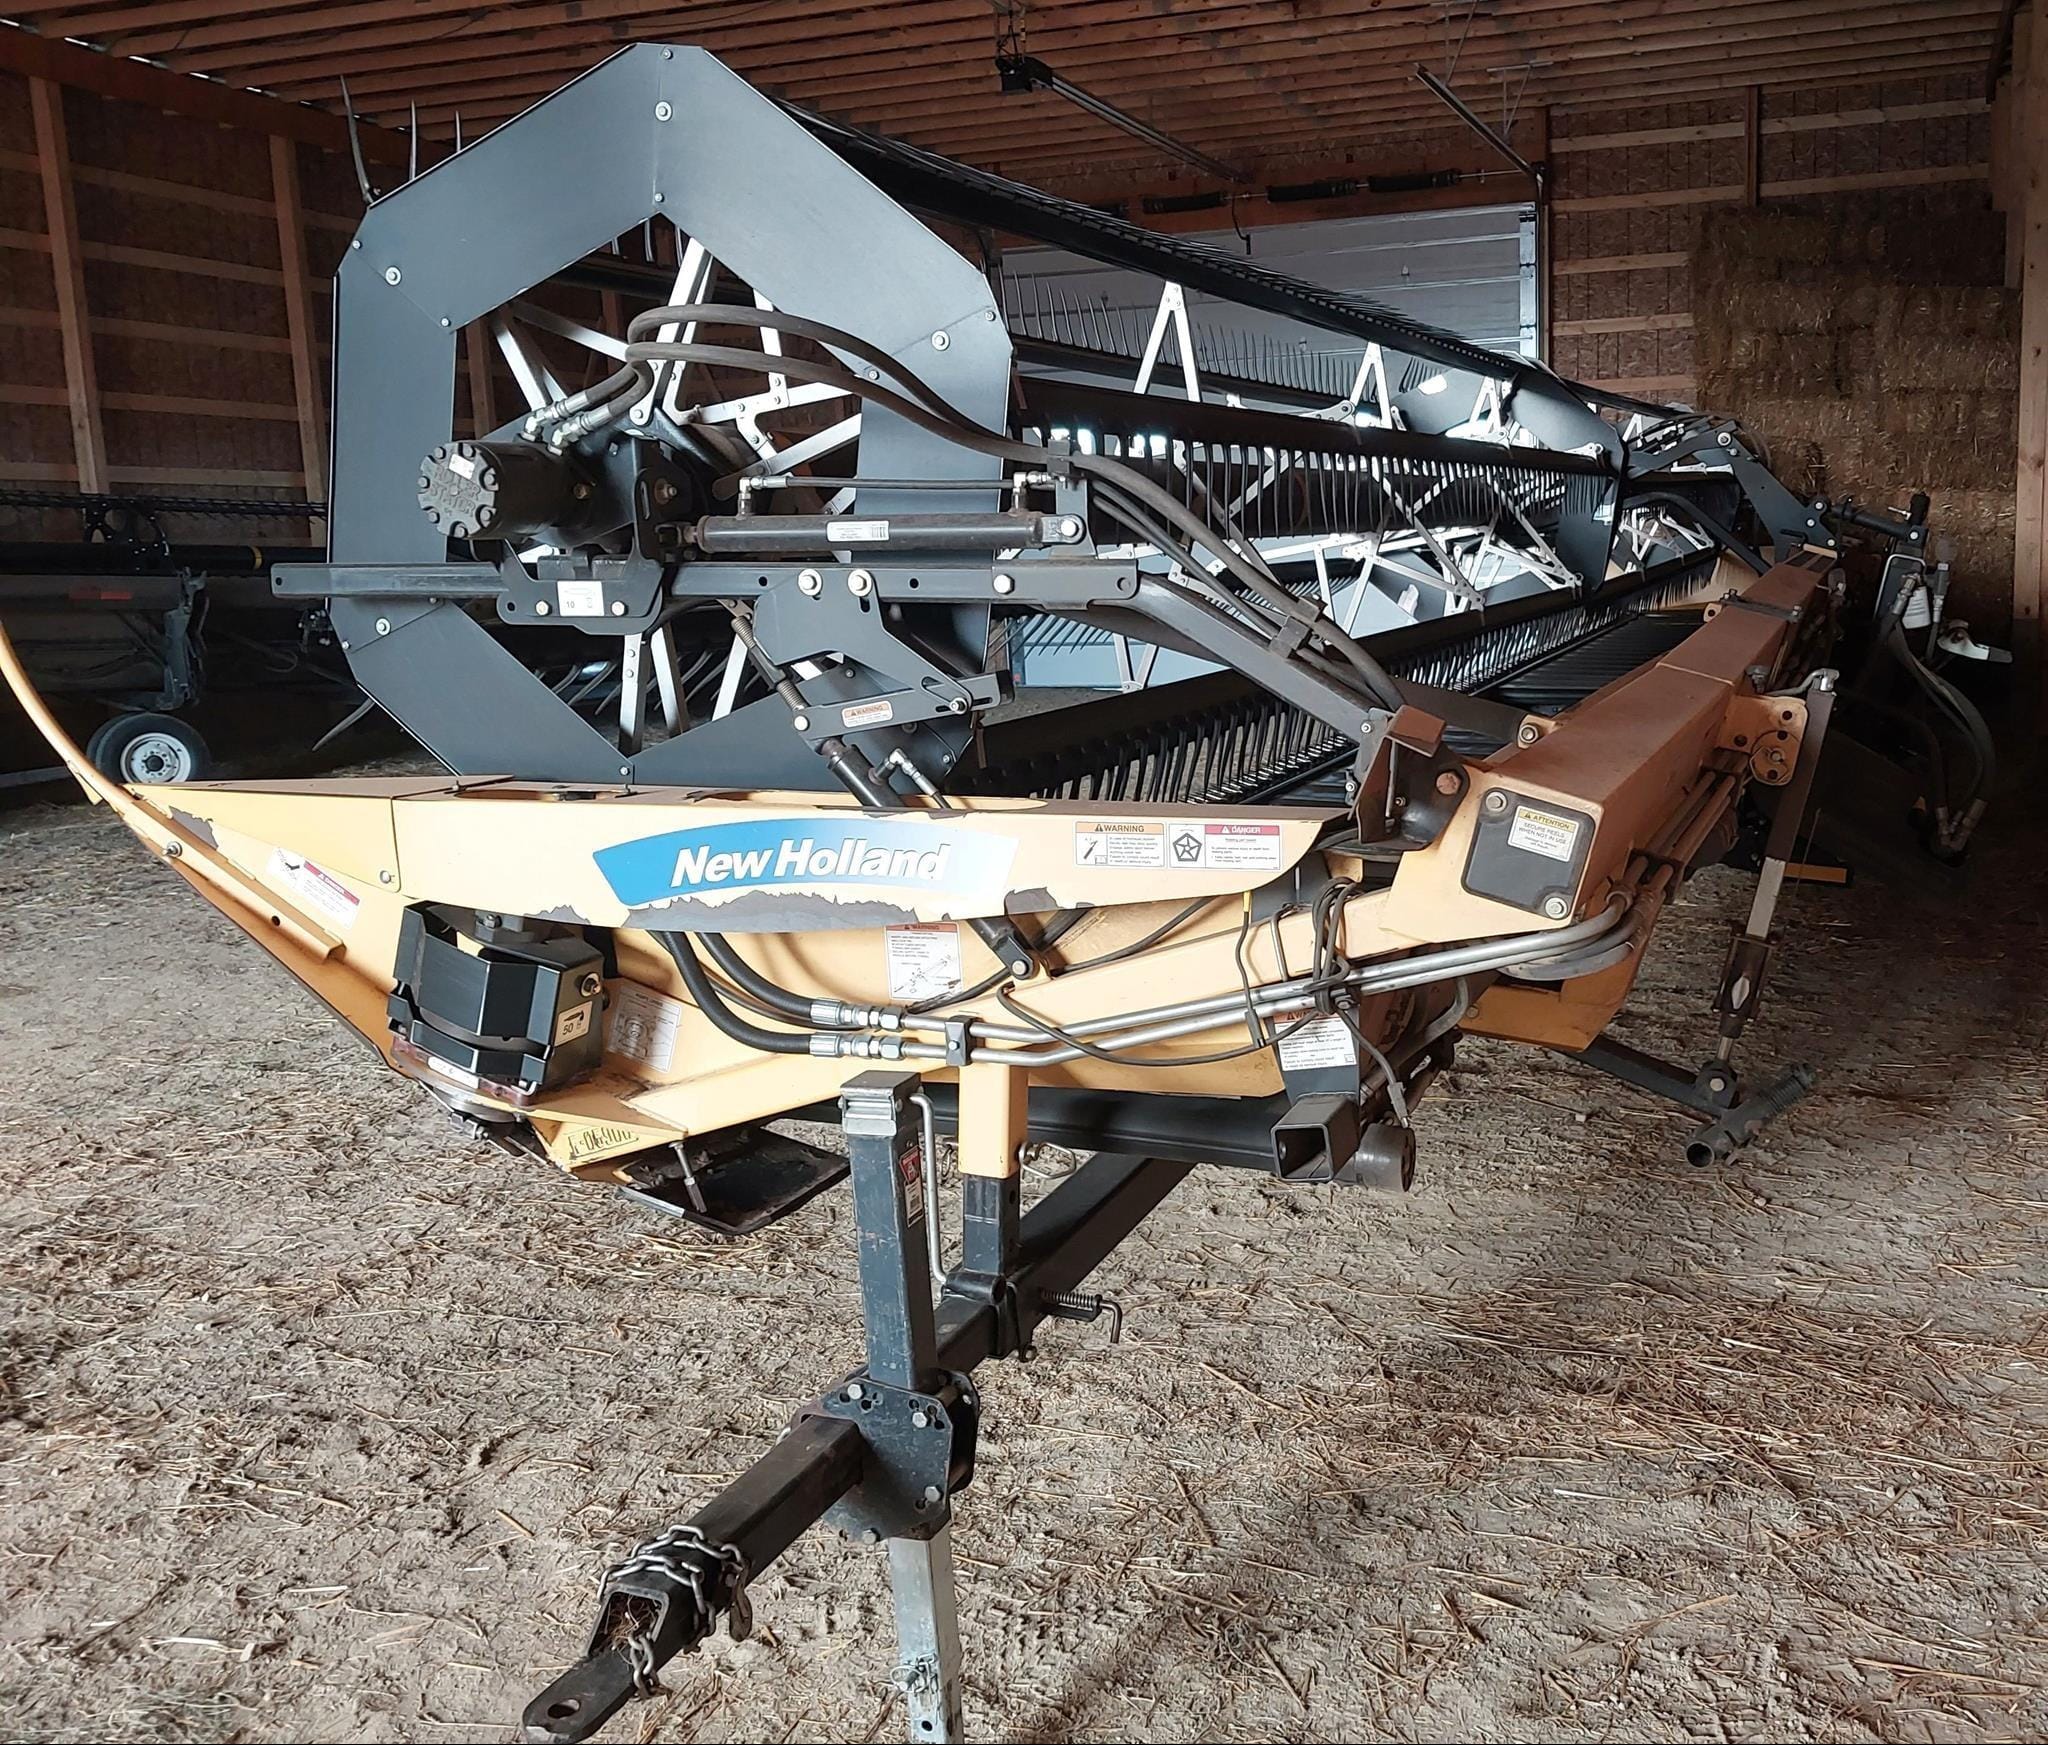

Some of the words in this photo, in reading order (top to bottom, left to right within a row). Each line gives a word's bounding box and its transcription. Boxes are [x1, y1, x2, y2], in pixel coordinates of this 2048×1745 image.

[566, 600, 576, 609] 10
[1533, 815, 1570, 829] ATTENTION
[1103, 824, 1145, 833] WARNING
[1230, 825, 1262, 835] DANGER
[1535, 831, 1548, 839] NOT
[670, 845, 775, 887] New
[772, 836, 952, 881] Holland
[562, 1022, 574, 1036] 50
